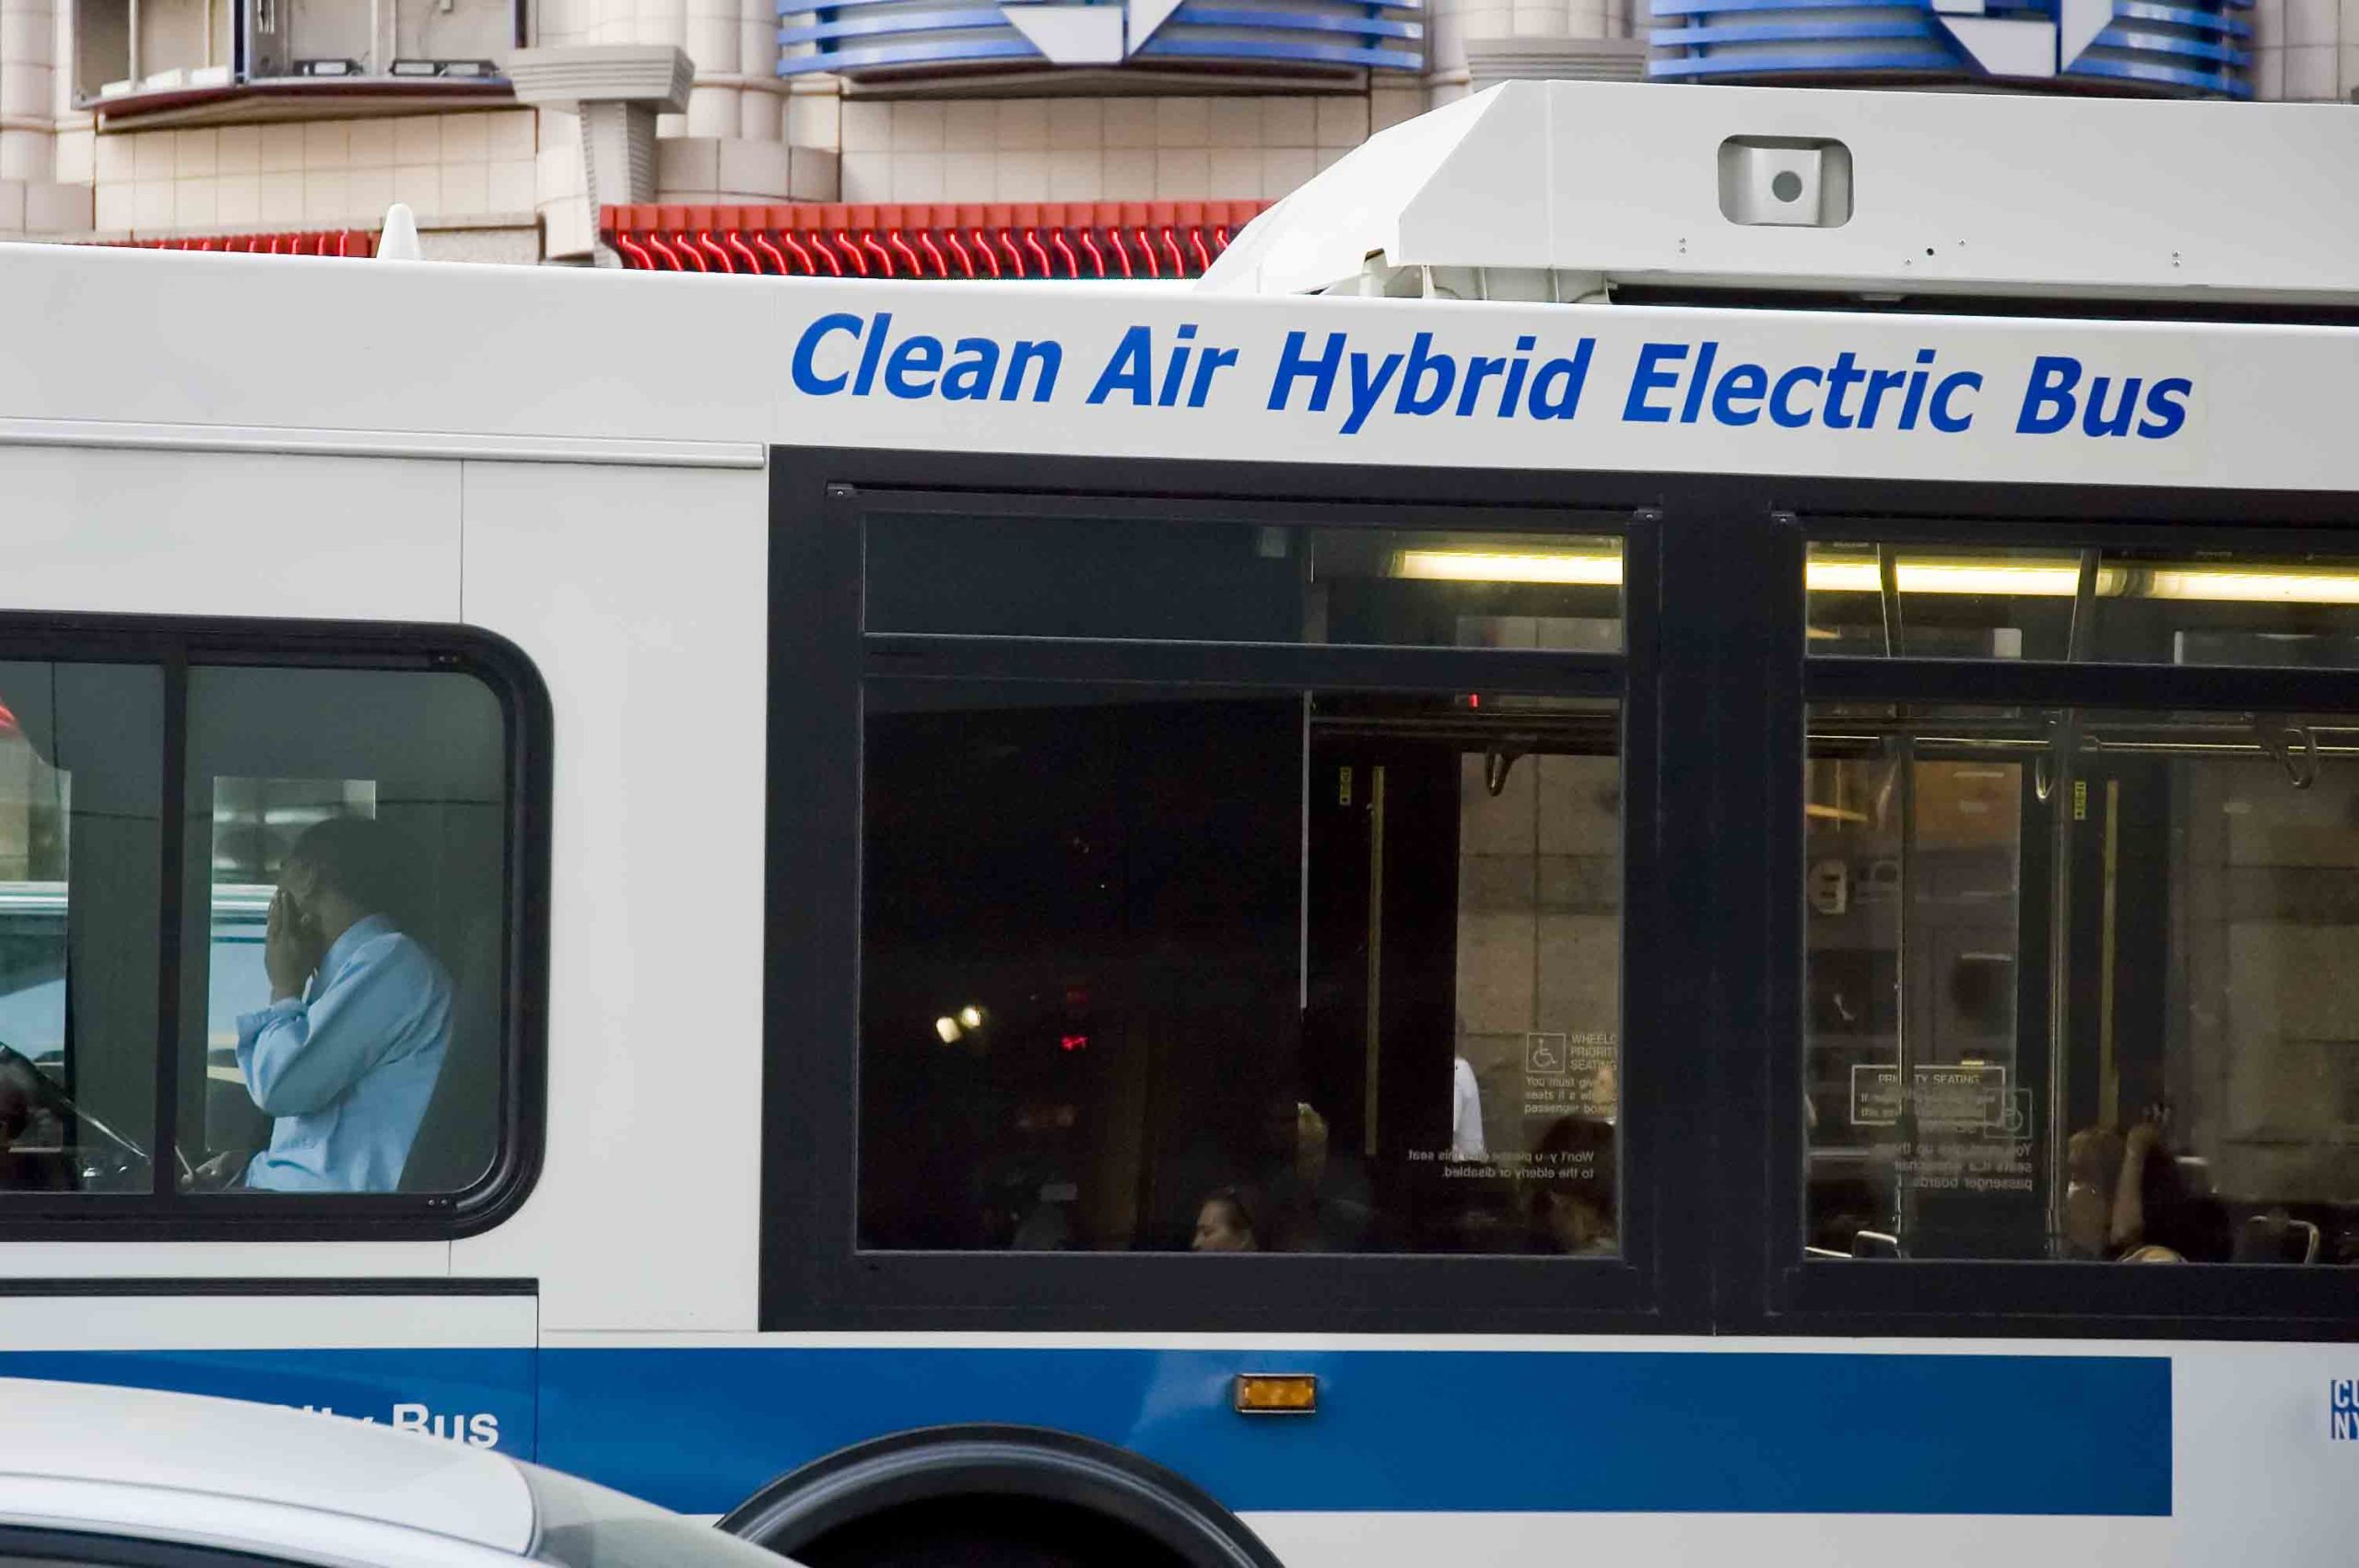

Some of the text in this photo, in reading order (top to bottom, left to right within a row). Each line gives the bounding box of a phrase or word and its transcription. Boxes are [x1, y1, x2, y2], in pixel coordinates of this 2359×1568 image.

[792, 313, 2191, 439] Clean Air Hybrid Electric Bus
[1570, 1059, 1618, 1071] SEATING
[1878, 1073, 1981, 1085] PRITY SEATING
[393, 1403, 499, 1450] Bus
